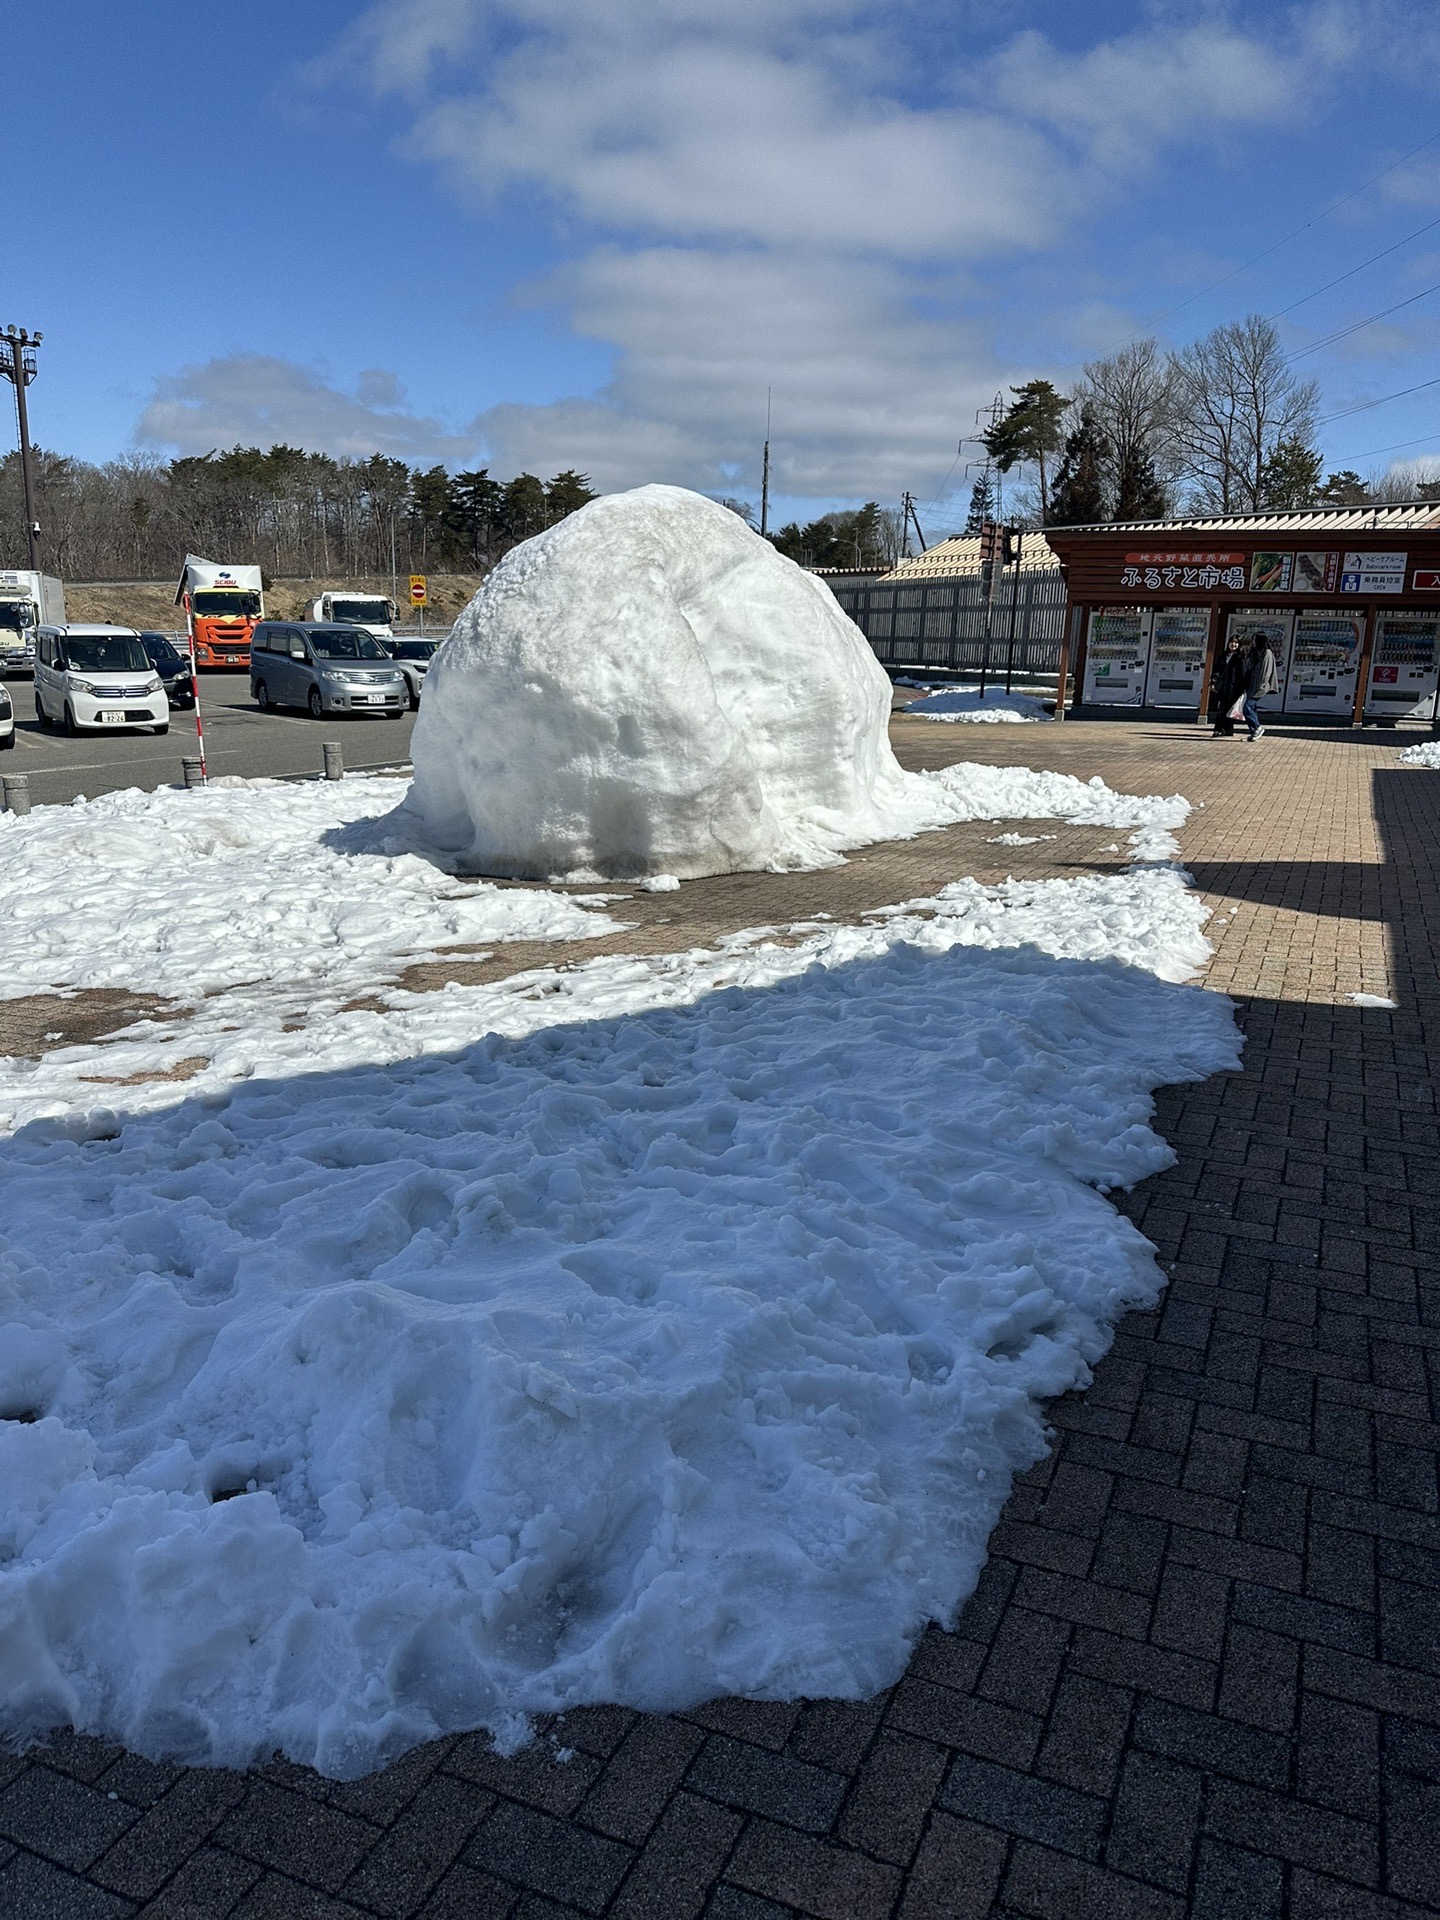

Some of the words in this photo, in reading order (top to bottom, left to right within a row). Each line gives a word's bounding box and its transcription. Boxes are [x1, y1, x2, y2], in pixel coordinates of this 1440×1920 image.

[1139, 553, 1231, 563] 地元野菜直売所
[1120, 564, 1245, 589] ふるさと市場
[1280, 556, 1292, 589] 新鮮野菜
